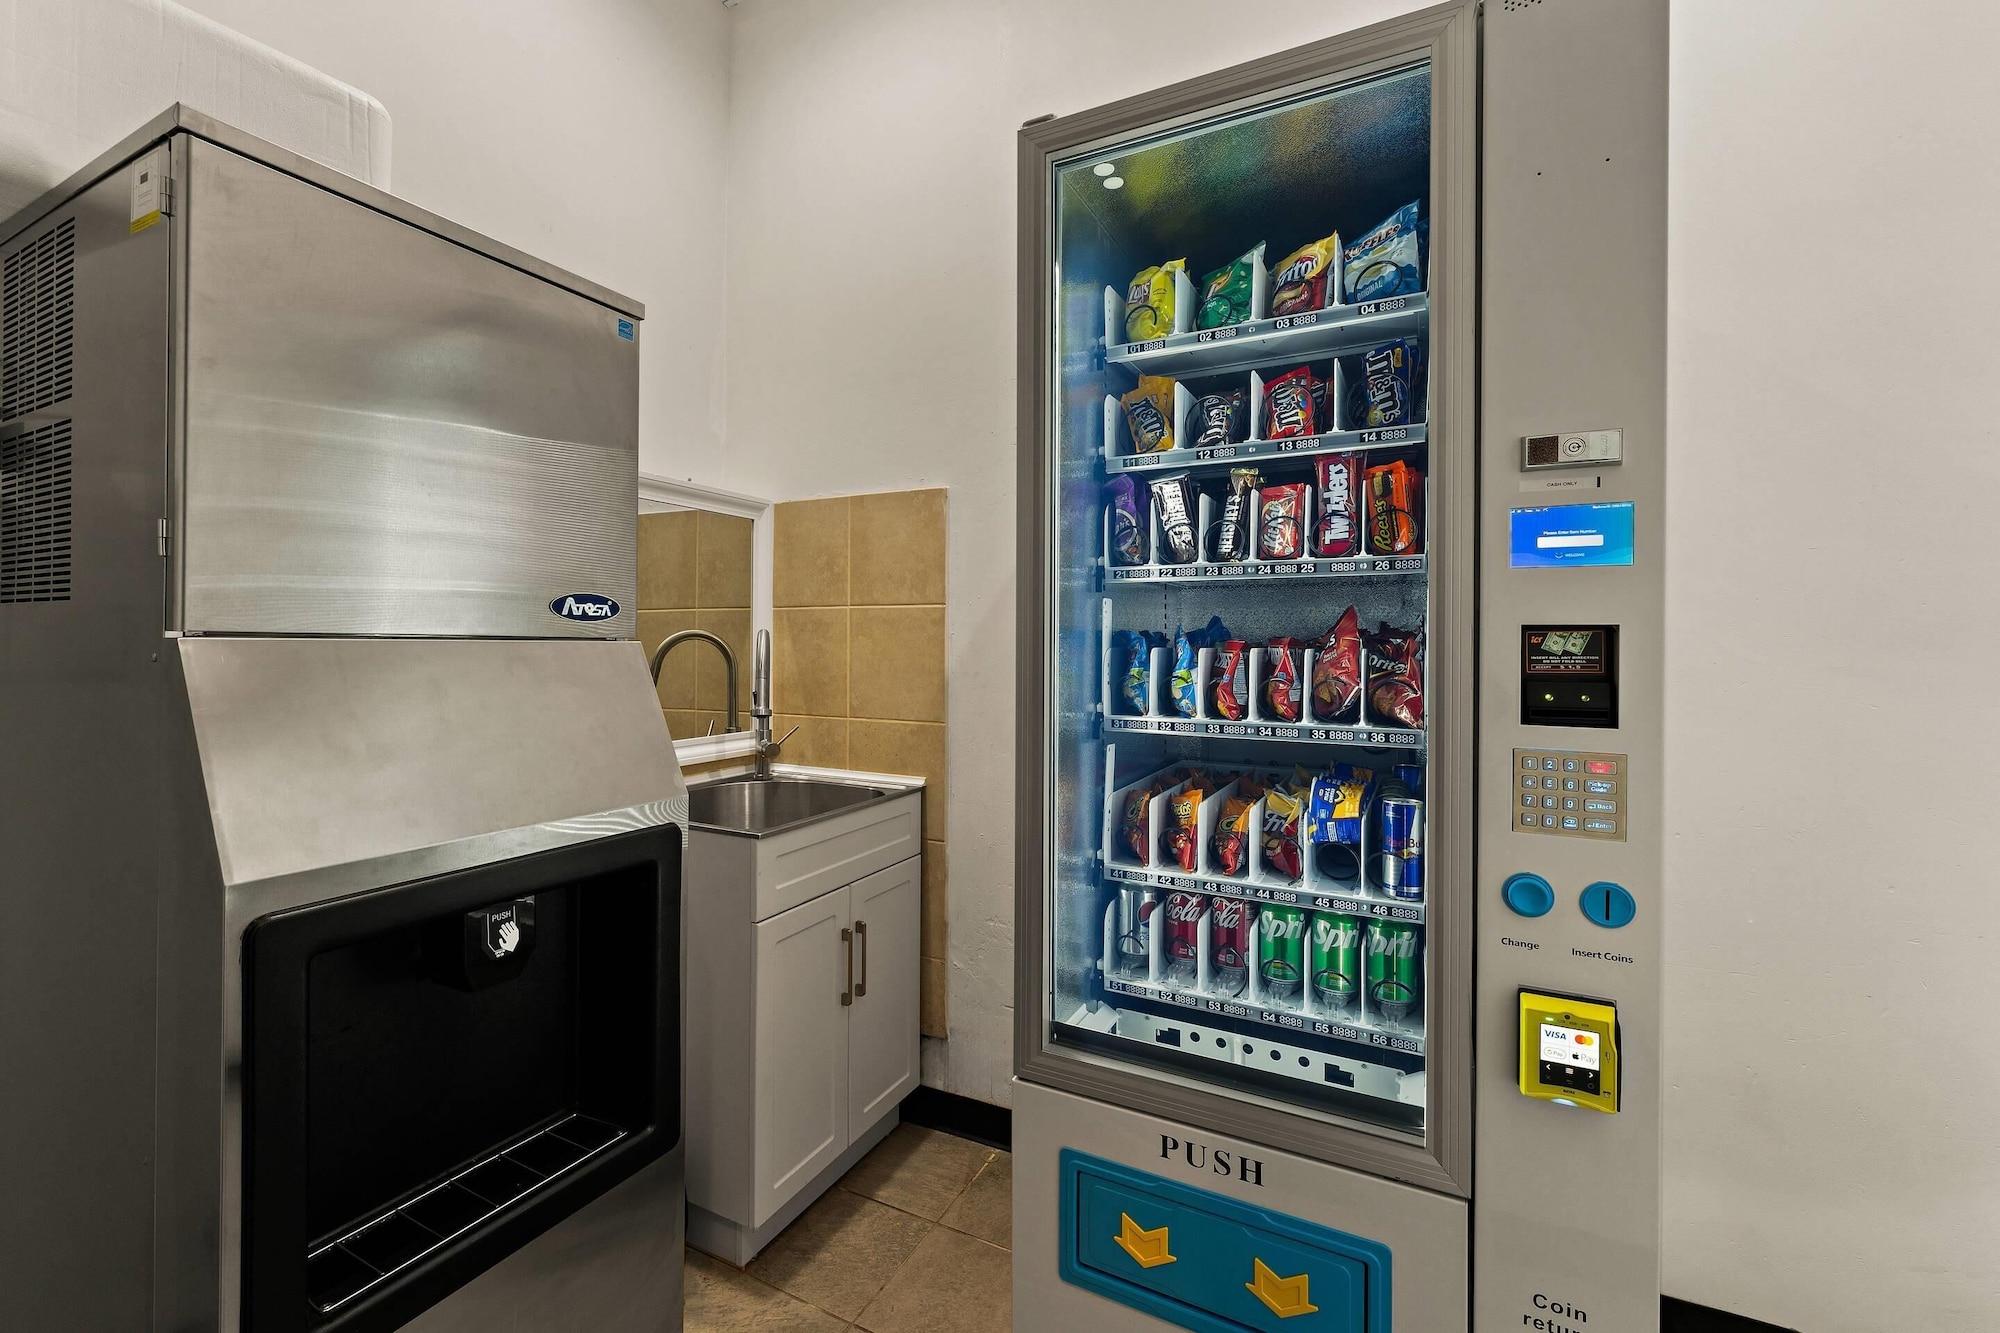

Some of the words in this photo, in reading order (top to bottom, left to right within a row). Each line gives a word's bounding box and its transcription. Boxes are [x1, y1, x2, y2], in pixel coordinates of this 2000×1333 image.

[1357, 281, 1383, 300] ORIGINAL
[1361, 305, 1375, 315] 04
[1379, 300, 1405, 312] 8888
[1276, 319, 1290, 329] 03
[1293, 314, 1317, 326] 8888
[1200, 333, 1212, 342] 02
[1215, 328, 1237, 339] 8888
[1362, 433, 1377, 442] 14
[1381, 430, 1407, 440] 8888
[1279, 442, 1293, 450] 13
[1296, 440, 1320, 448] 8888
[1198, 451, 1211, 459] 12
[1214, 448, 1236, 457] 8888
[1206, 568, 1218, 576] 23
[1222, 566, 1244, 574] 8888
[1258, 566, 1271, 574] 24
[1274, 564, 1298, 574] 8888
[1300, 564, 1314, 573] 25
[1331, 562, 1356, 572] 8888
[1375, 561, 1390, 571] 26
[1394, 560, 1421, 569] 8888
[1160, 568, 1173, 577] 22
[1176, 568, 1196, 576] 8888
[1160, 722, 1172, 730] 32
[1174, 722, 1196, 732] 8888
[1208, 724, 1220, 733] 33
[1223, 725, 1246, 734] 8888
[1258, 727, 1272, 736] 34
[1275, 728, 1298, 738] 8888
[1312, 730, 1326, 740] 35
[1329, 730, 1354, 740] 8888
[1370, 732, 1386, 742] 36
[1389, 733, 1415, 744] 8888
[1547, 760, 1552, 768] 2
[1568, 762, 1574, 770] 3
[1568, 800, 1573, 808] 9
[1158, 876, 1172, 885] 42
[1174, 878, 1196, 888] 8888
[1204, 882, 1218, 892] 43
[1220, 884, 1242, 895] 8888
[1256, 890, 1270, 899] 44
[1274, 892, 1297, 902] 8888
[1315, 898, 1330, 908] 45
[1332, 900, 1358, 911] 8888
[492, 910, 512, 922] PUSH
[1372, 906, 1388, 916] 46
[1392, 908, 1418, 920] 8888
[1501, 938, 1540, 950] Change
[1572, 948, 1602, 960] Insert
[1604, 952, 1634, 964] Coins
[1160, 992, 1173, 1000] 52
[1174, 994, 1196, 1006] 8888
[1208, 1001, 1221, 1010] 53
[1223, 1004, 1246, 1016] 8888
[1262, 1012, 1276, 1022] 54
[1279, 1015, 1303, 1028] 8888
[1314, 1022, 1329, 1033] 55
[1332, 1026, 1357, 1038] 8888
[1544, 1030, 1566, 1040] VISA
[1372, 1034, 1388, 1045] 56
[1390, 1038, 1417, 1051] 8888
[1580, 1054, 1596, 1065] Pay
[1160, 1134, 1265, 1187] PUSH
[1532, 1294, 1586, 1322] Coin
